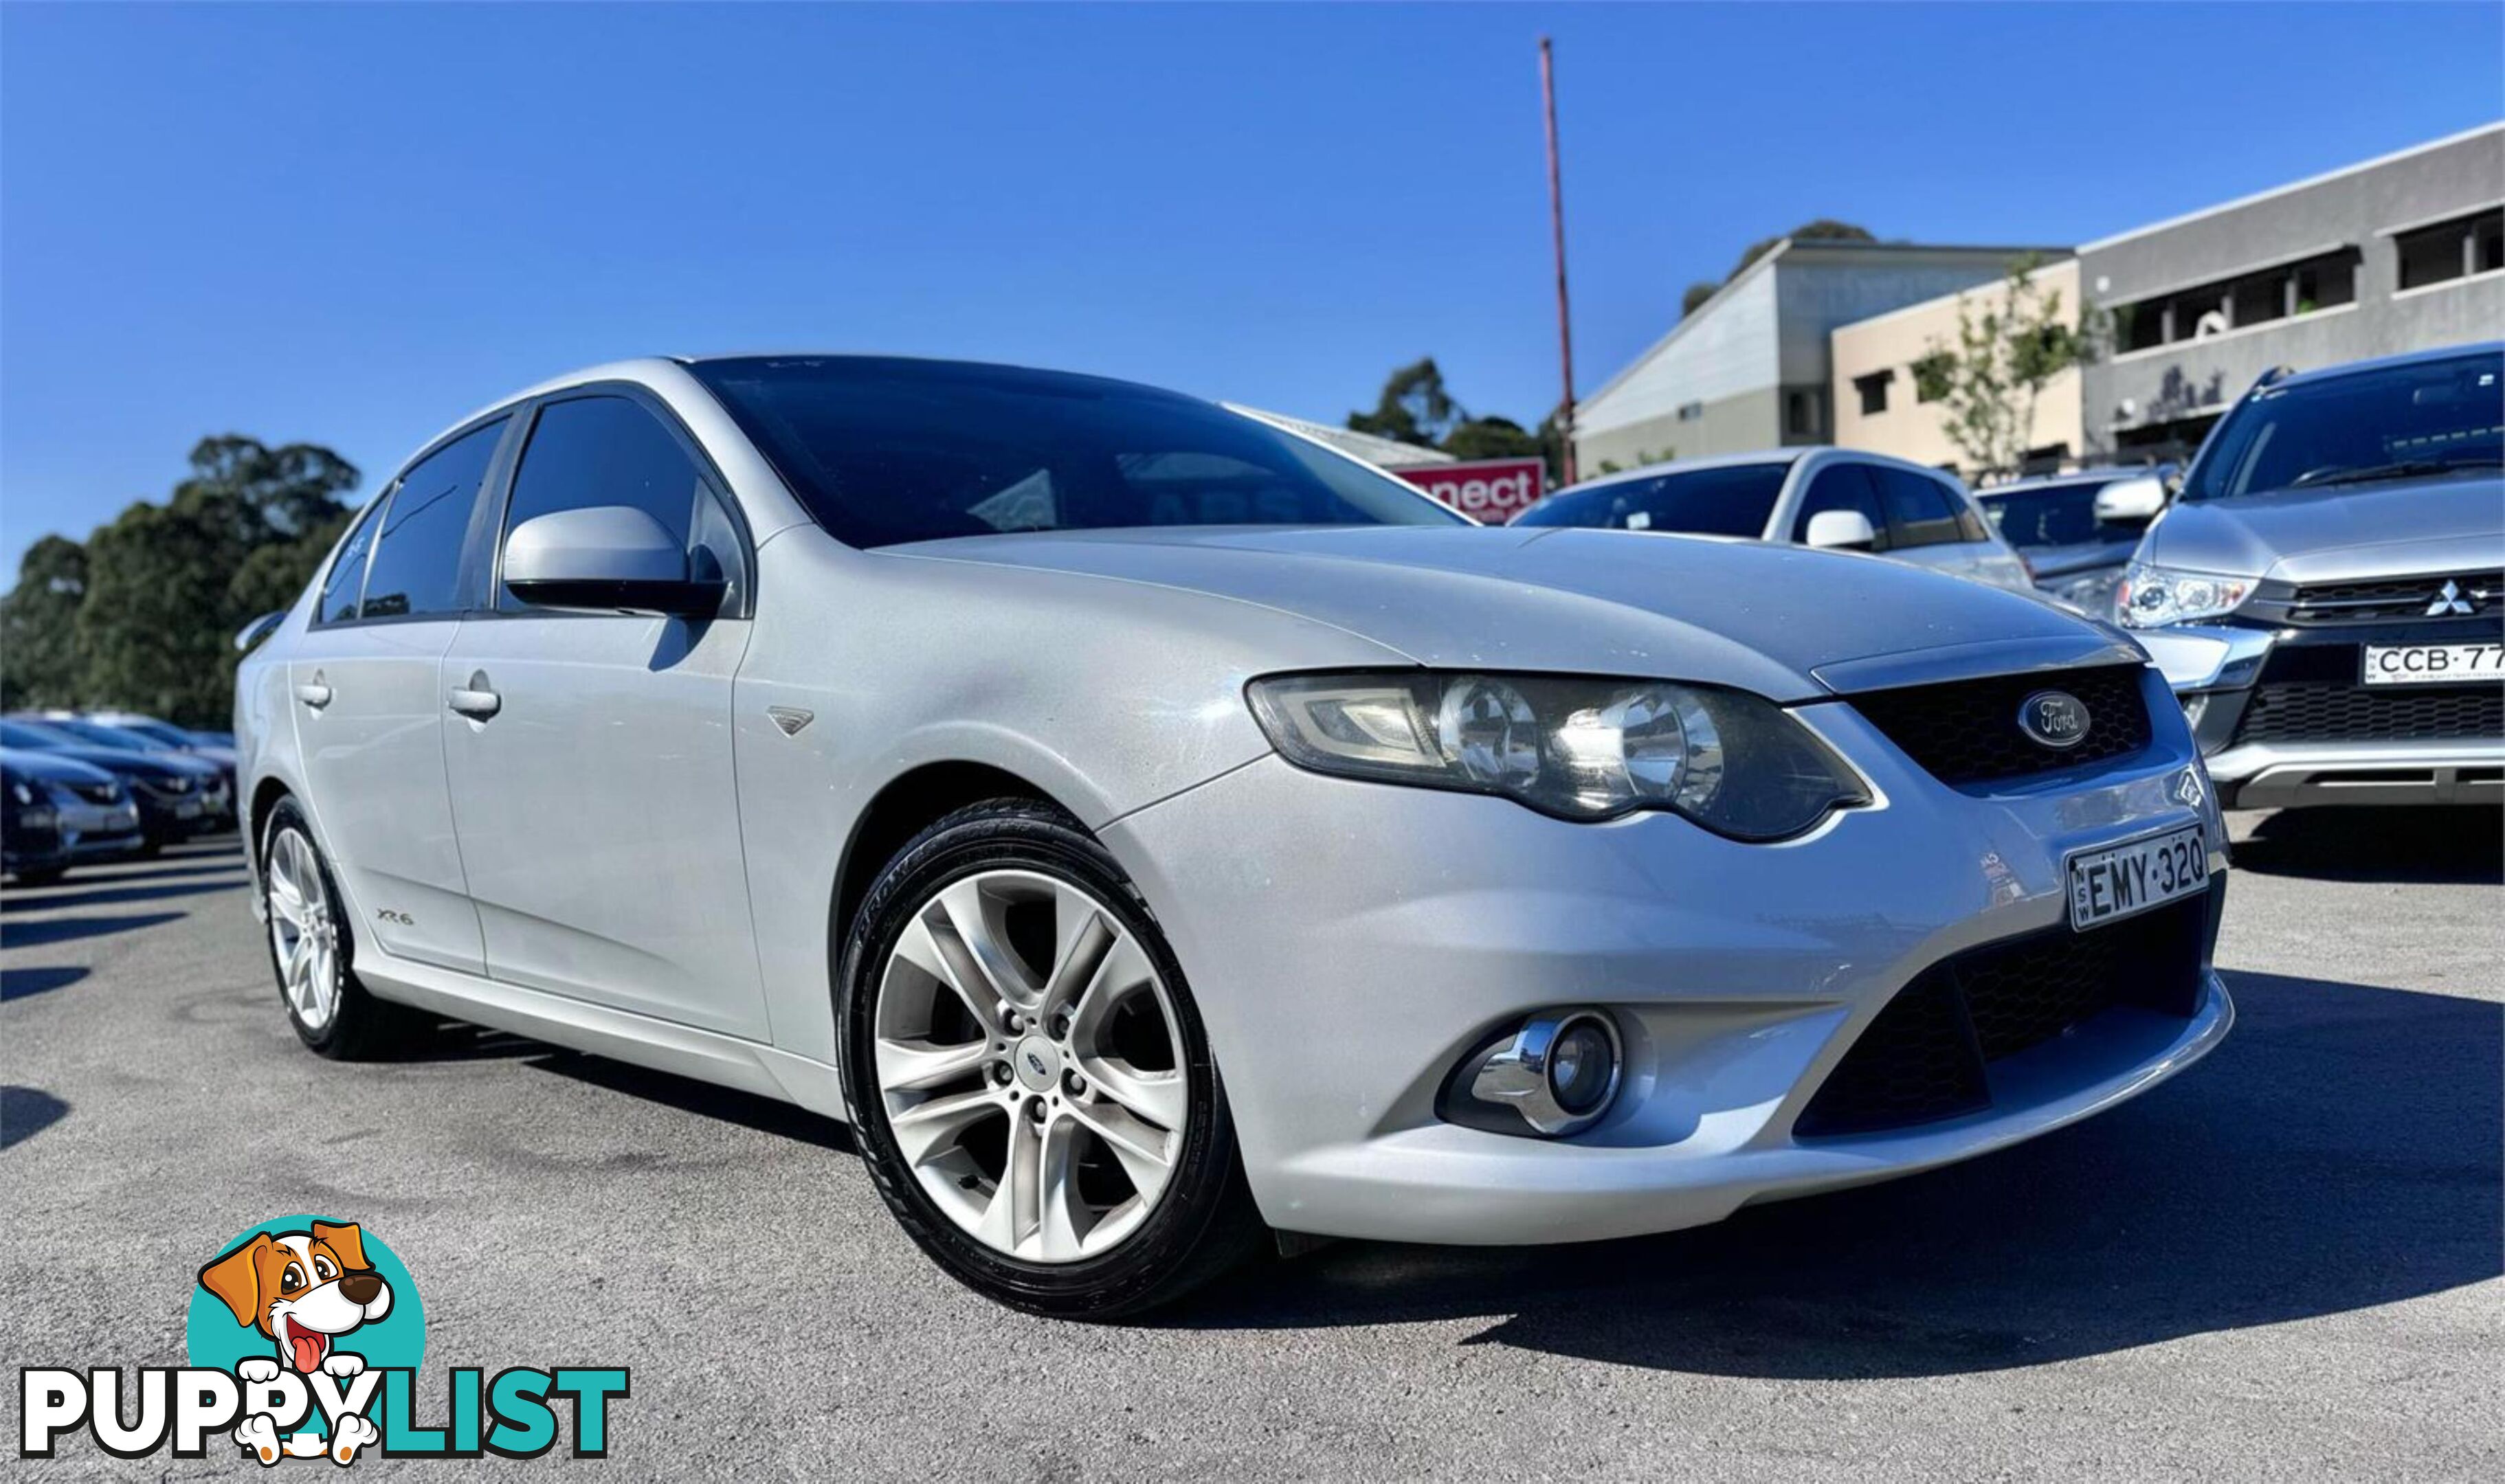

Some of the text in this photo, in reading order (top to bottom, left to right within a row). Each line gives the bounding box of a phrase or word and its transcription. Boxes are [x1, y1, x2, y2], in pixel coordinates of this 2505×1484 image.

[2040, 701, 2078, 733] Ford
[2075, 868, 2089, 921] NSW
[377, 908, 414, 925] XR6
